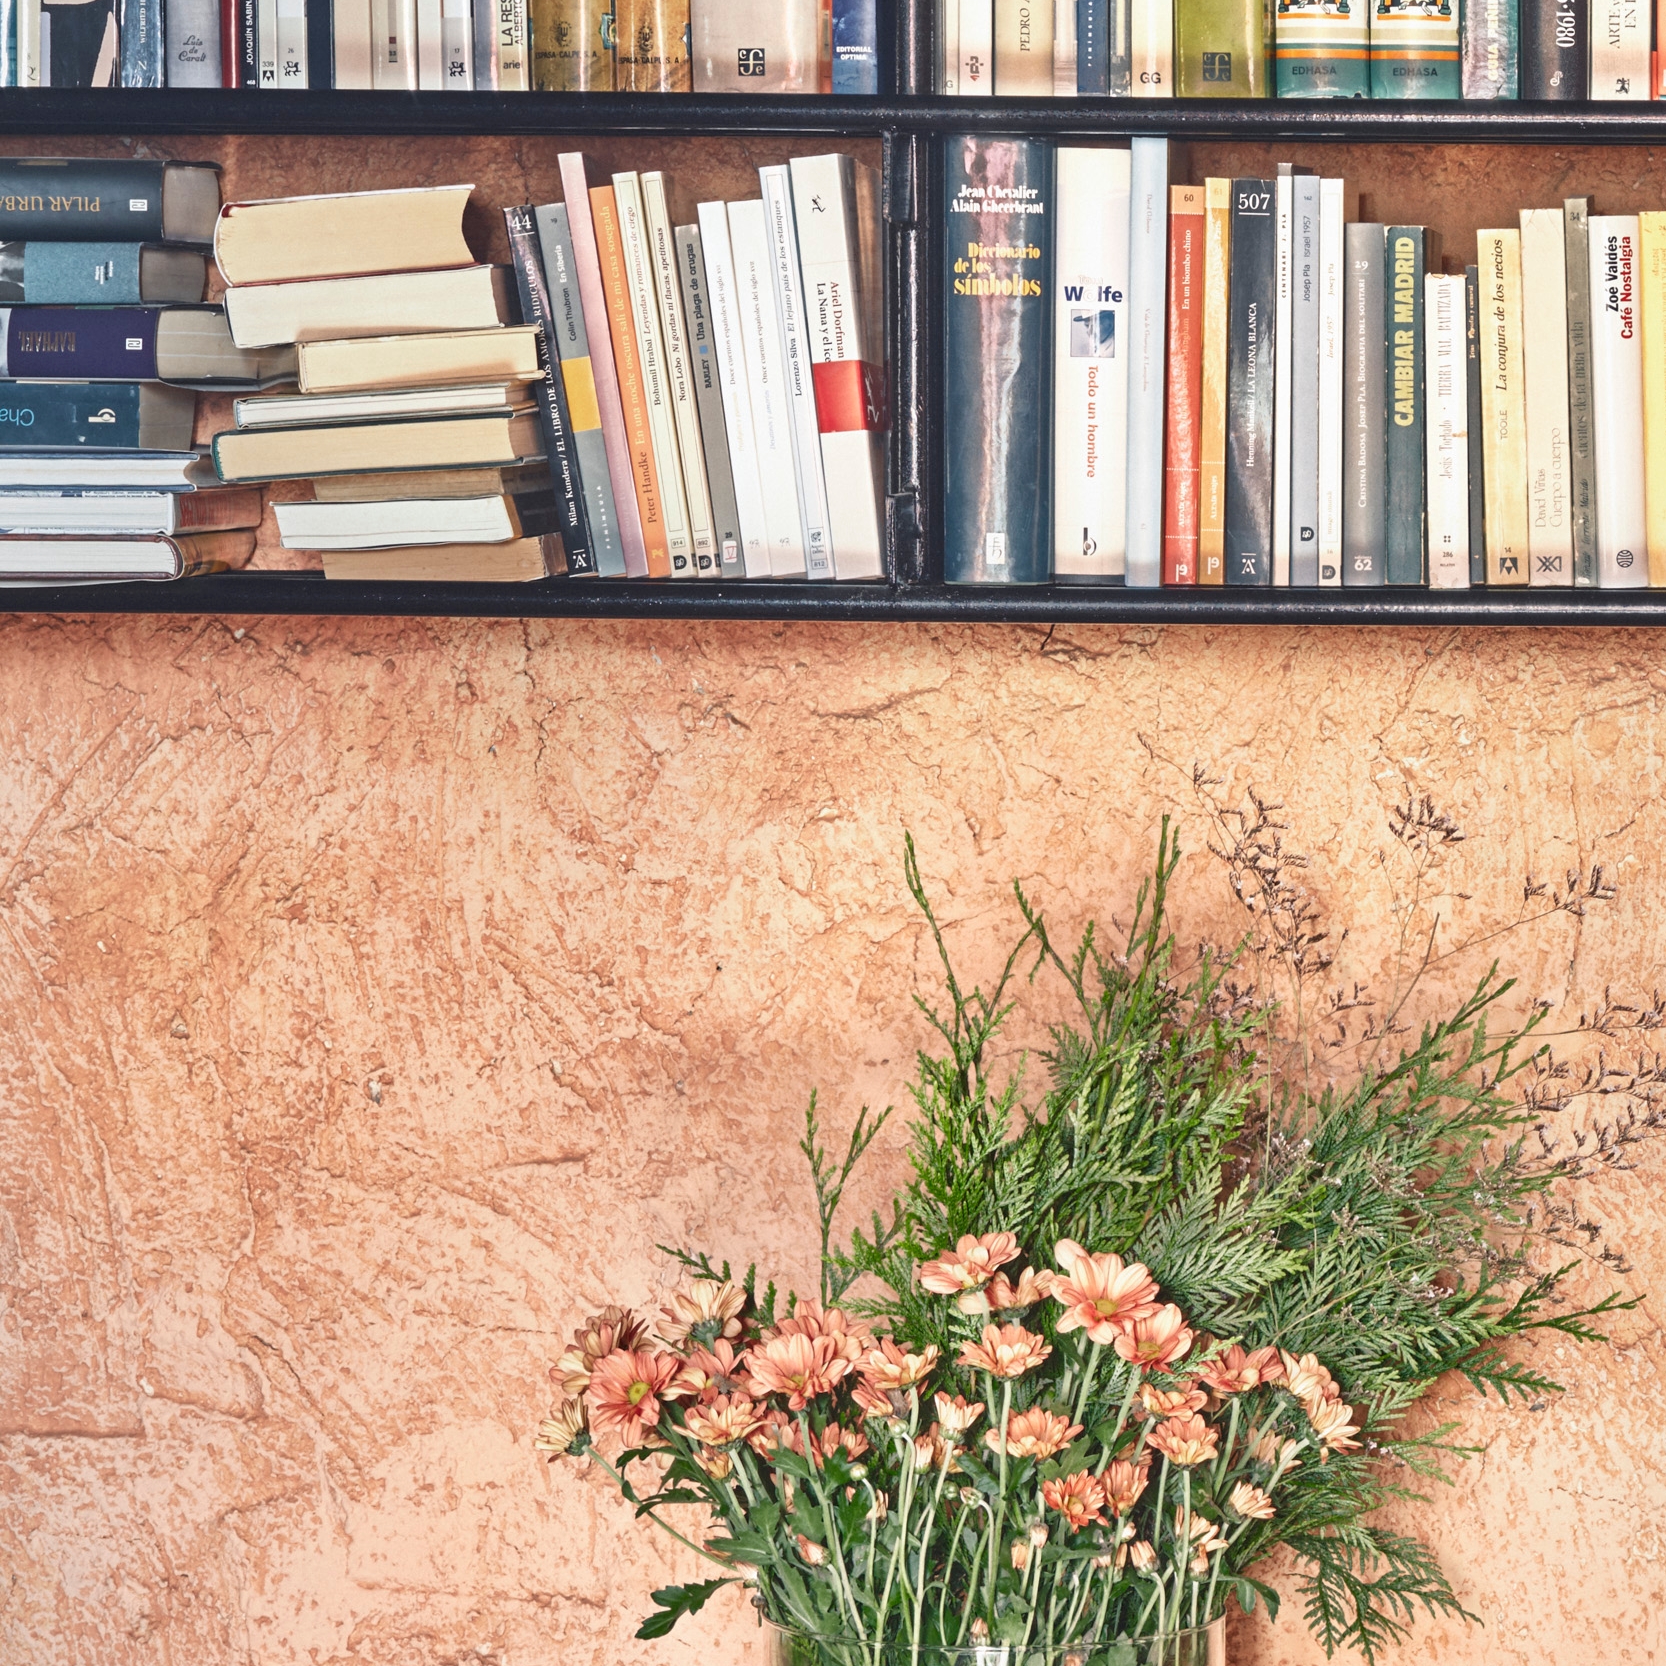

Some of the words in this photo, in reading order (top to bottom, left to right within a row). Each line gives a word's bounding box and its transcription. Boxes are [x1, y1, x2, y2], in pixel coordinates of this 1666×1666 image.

[1292, 63, 1336, 78] EDHASA
[1238, 193, 1270, 210] 507
[511, 214, 532, 231] 44
[1606, 236, 1618, 281] Valdés
[1619, 237, 1633, 302] Nostalgia
[829, 282, 840, 307] Ariel
[1395, 235, 1416, 324] MADRID
[1606, 287, 1619, 312] Zoé
[832, 309, 845, 359] Dorfman
[1620, 307, 1633, 339] Café
[1088, 365, 1099, 398] Todo
[1394, 327, 1415, 429] CAMBIAR
[1087, 402, 1096, 419] un
[1087, 424, 1098, 478] hombre
